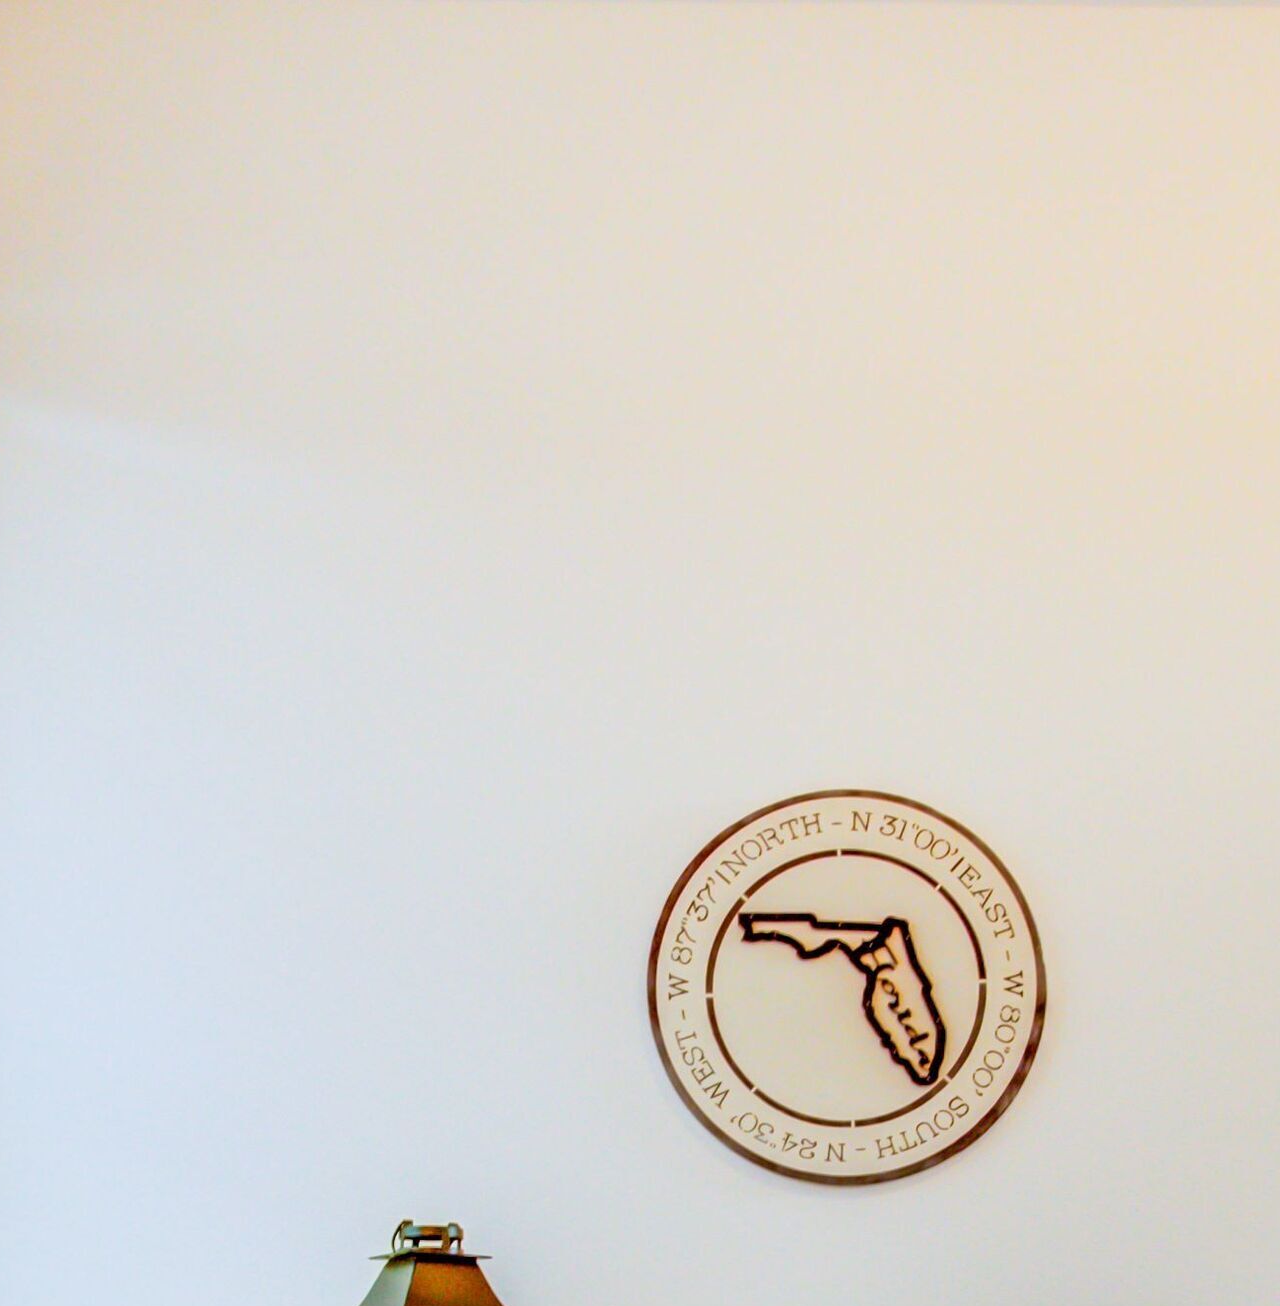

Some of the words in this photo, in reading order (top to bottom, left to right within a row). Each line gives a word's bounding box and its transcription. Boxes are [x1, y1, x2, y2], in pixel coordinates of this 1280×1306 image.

[850, 810, 873, 833] N
[720, 812, 823, 877] NORTH
[957, 863, 1015, 939] EAST
[668, 973, 689, 1001] W
[1003, 970, 1024, 998] W
[674, 1029, 732, 1110] WEST
[875, 1096, 970, 1159] SOUTH
[824, 1142, 846, 1162] N
